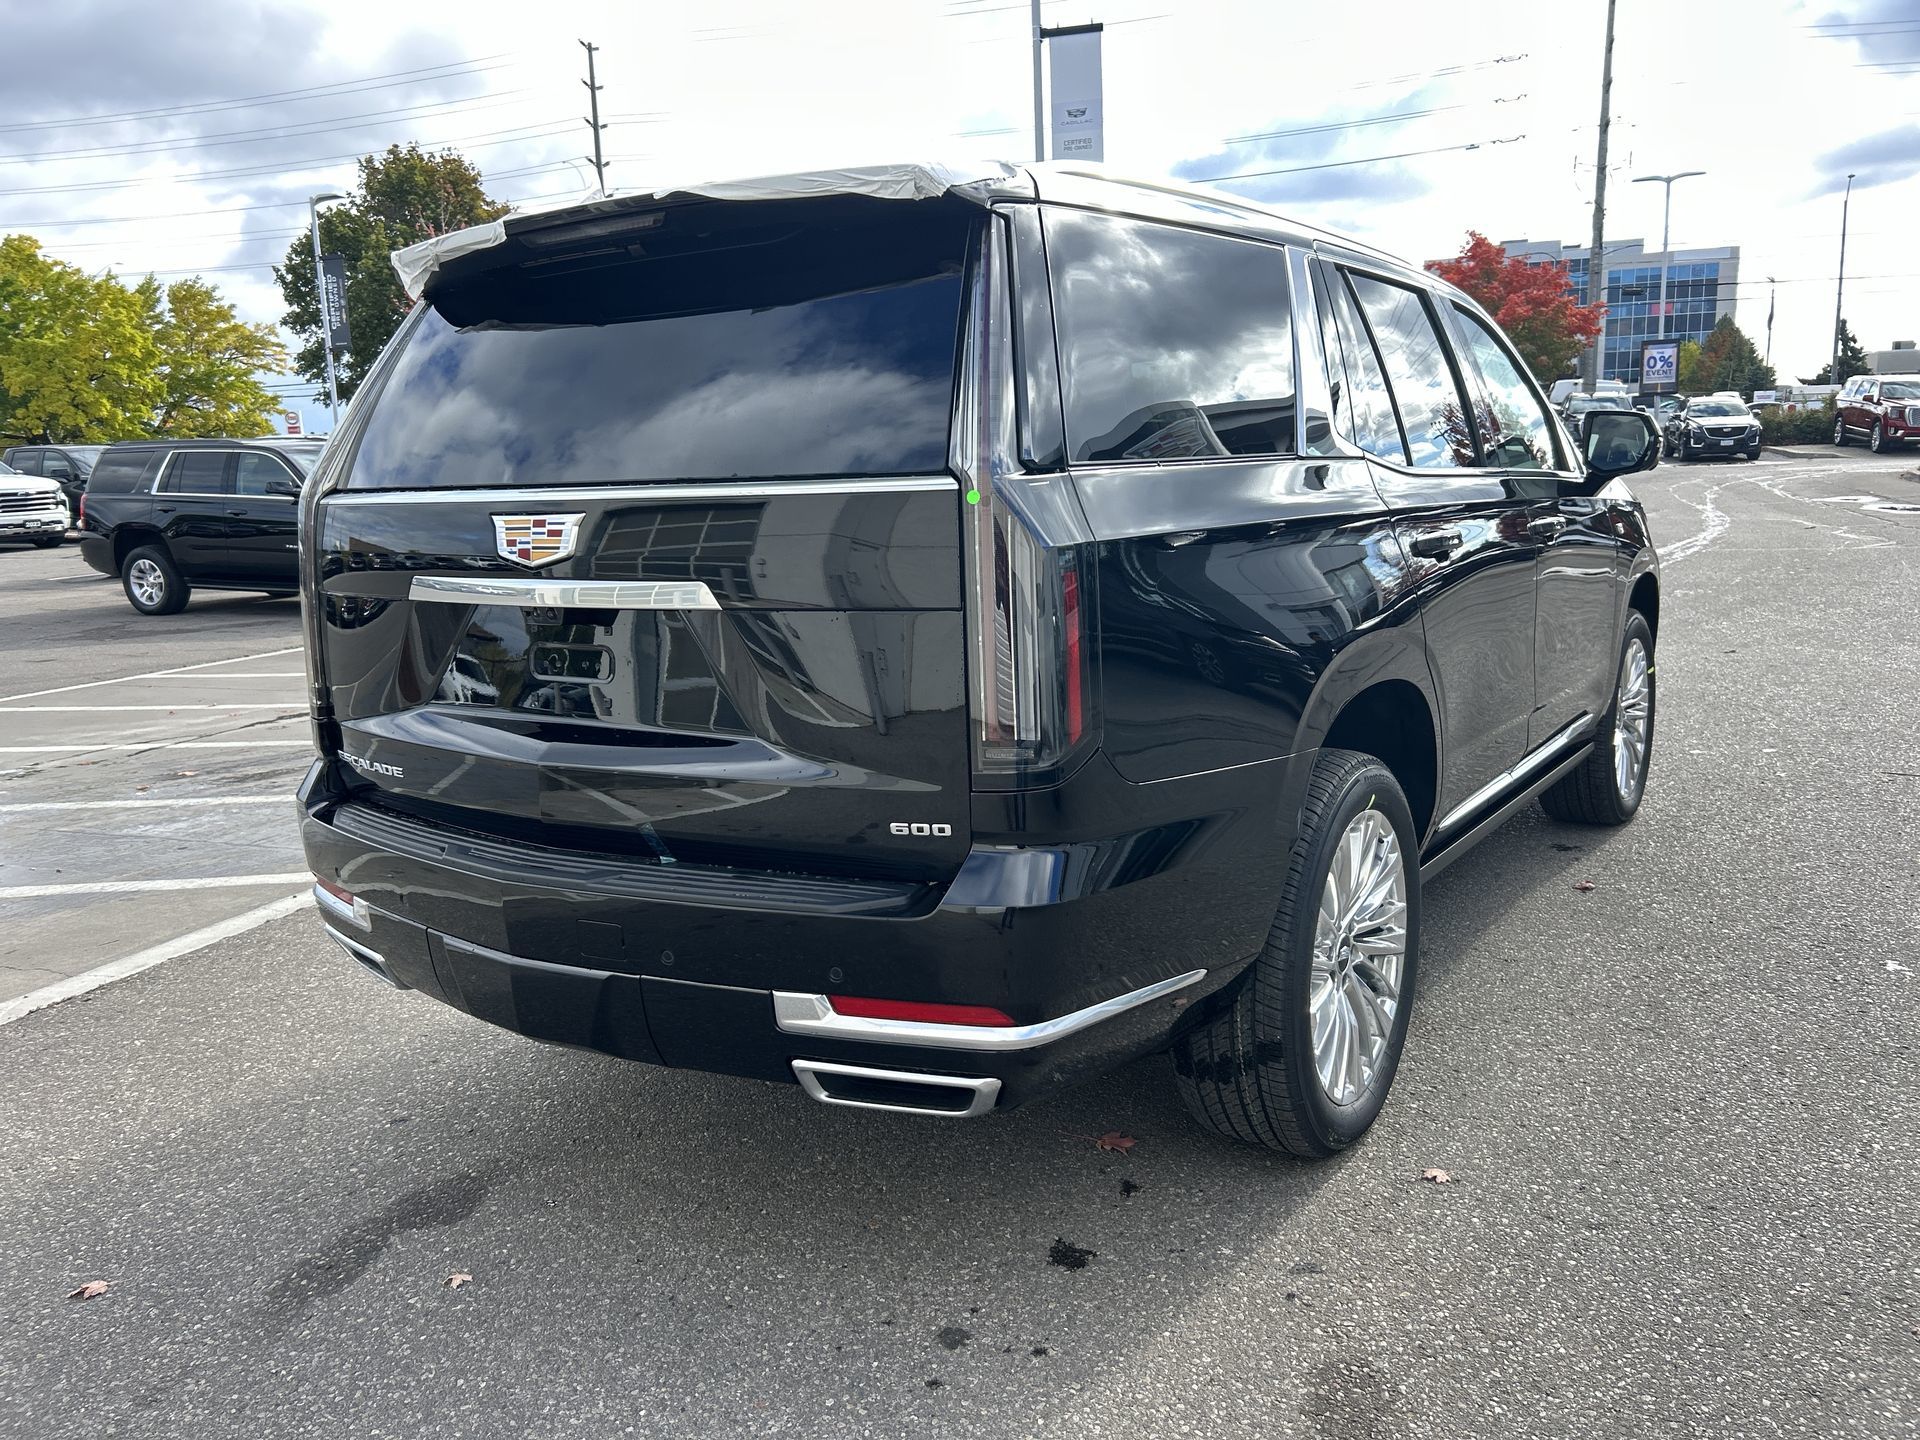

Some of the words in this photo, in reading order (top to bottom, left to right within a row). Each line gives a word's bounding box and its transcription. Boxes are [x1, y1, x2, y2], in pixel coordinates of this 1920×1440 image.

[1063, 137, 1093, 147] CERTIFIED
[327, 274, 338, 330] CERTIFIED
[1646, 355, 1673, 370] 0%
[1646, 369, 1674, 377] EVENT
[337, 750, 404, 778] ESCALADE
[889, 822, 952, 837] 600
